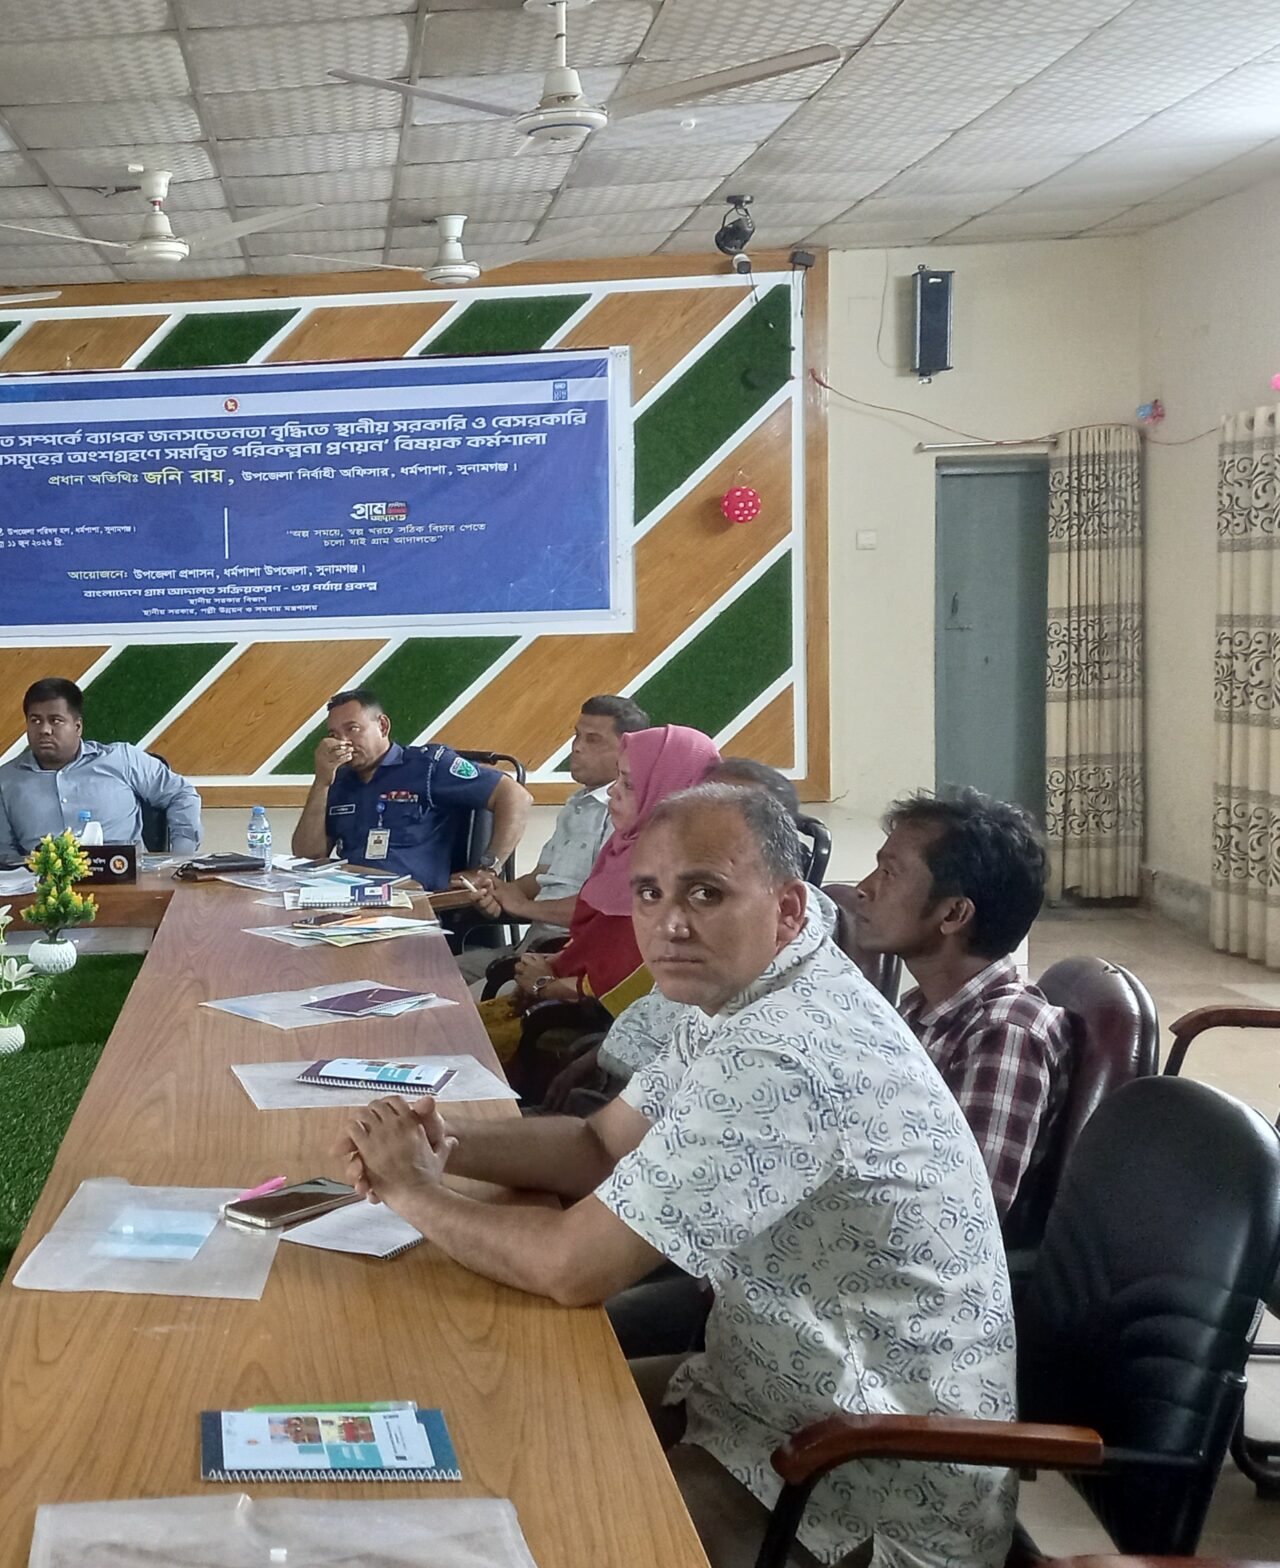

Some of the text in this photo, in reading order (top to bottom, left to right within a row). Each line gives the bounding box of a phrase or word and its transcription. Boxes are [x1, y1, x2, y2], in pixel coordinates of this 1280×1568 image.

[17, 428, 83, 446] সম্পর্কে
[84, 431, 145, 444] ব্যাপক
[147, 426, 267, 442] জনসচেতনতা
[269, 421, 330, 442] বৃদ্ধিতে
[332, 417, 390, 437] স্থানীয়
[392, 414, 468, 433] সরকারি
[471, 417, 487, 429] ও
[491, 408, 587, 428] বেসরকারি
[66, 448, 161, 463] অংশগ্রহণে
[164, 443, 228, 462] সমন্বিত
[232, 441, 322, 458] পরিকল্পনা
[393, 434, 463, 451] বিষয়ক
[465, 430, 548, 448] কর্মশালা
[48, 474, 85, 486] প্রধান
[141, 466, 184, 485] জনি
[241, 470, 294, 481] উপজেলা
[296, 466, 337, 480] নির্বাহী
[350, 501, 386, 521] গ্রাম
[6, 528, 35, 536] উপজেলা
[36, 526, 58, 535] পরিষদ
[368, 527, 394, 535] খরচে
[397, 523, 425, 534] সঠিক
[428, 523, 455, 533] বিচার
[459, 523, 486, 532] পেতে
[17, 539, 30, 548] জুন
[323, 539, 345, 547] চলো
[349, 537, 367, 546] যাই
[370, 537, 389, 545] গ্রাম
[132, 568, 177, 580] উপজেলা
[223, 564, 262, 577] ধর্মপাশা
[83, 589, 142, 597] বাংলাদেশে
[143, 588, 166, 597] গ্রাম
[166, 586, 216, 595] আদালত
[217, 584, 282, 594] সক্রিয়করণ
[291, 583, 310, 593] ৩য়
[312, 580, 343, 591] পর্যায়
[344, 581, 377, 591] প্রকল্প
[187, 596, 212, 605] স্থানীয়
[243, 595, 267, 603] বিভাগ
[142, 607, 165, 616] স্থানীয়
